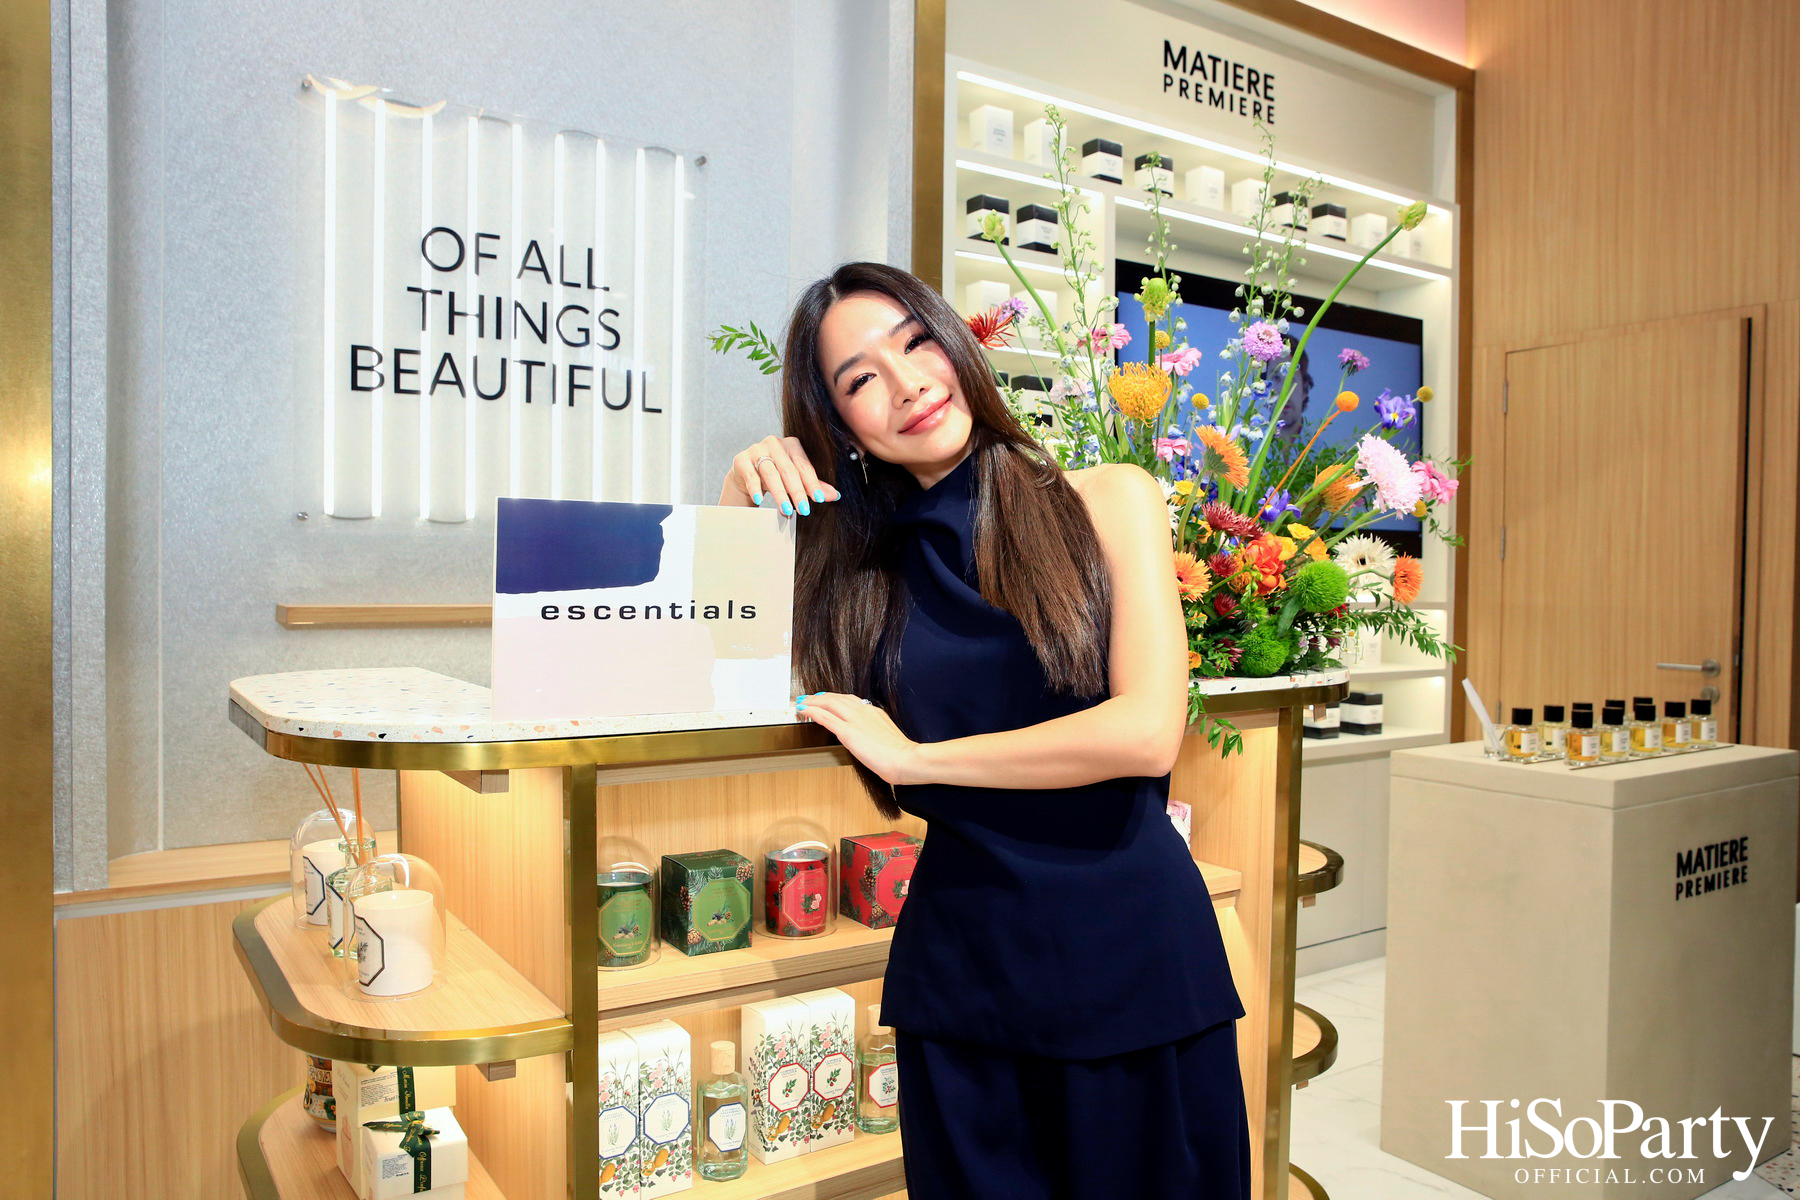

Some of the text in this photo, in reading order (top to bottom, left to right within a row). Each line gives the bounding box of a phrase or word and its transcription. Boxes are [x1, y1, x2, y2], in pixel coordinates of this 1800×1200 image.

[1164, 39, 1275, 102] MATIERE
[1164, 73, 1275, 125] PREMIERE
[421, 226, 610, 292] OF ALL
[407, 285, 621, 351] THINGS
[350, 344, 663, 414] BEAUTIFUL
[540, 600, 758, 620] escentials
[1675, 865, 1748, 901] PREMIERE
[1676, 836, 1748, 879] MATIERE
